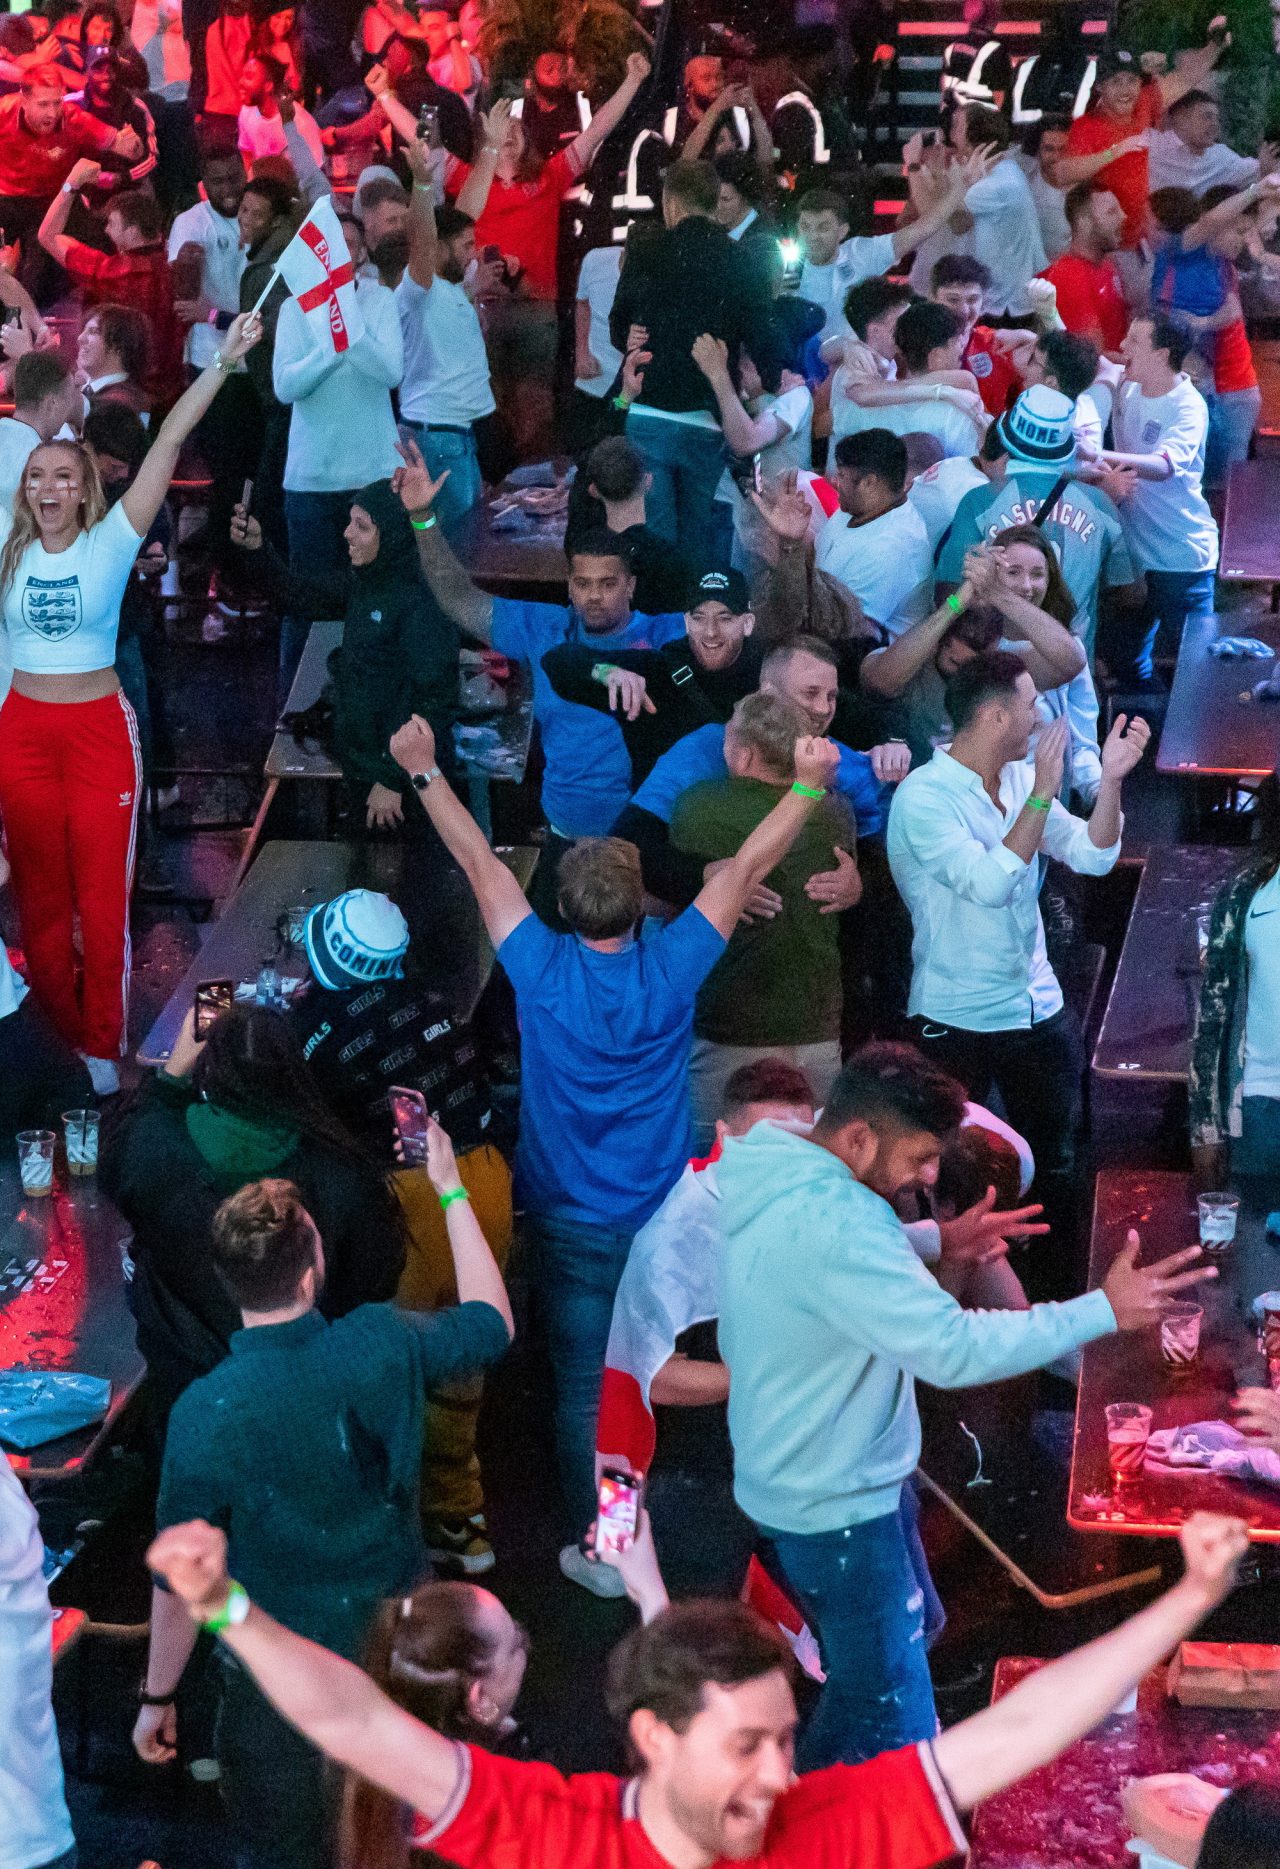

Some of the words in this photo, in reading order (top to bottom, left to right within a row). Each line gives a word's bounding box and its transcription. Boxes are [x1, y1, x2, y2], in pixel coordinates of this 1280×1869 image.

[1016, 417, 1060, 444] HOME
[989, 499, 1096, 543] GASCIGNE
[330, 931, 399, 976] COMIN
[423, 1019, 451, 1043] GIRLS
[1096, 1511, 1126, 1523] 12
